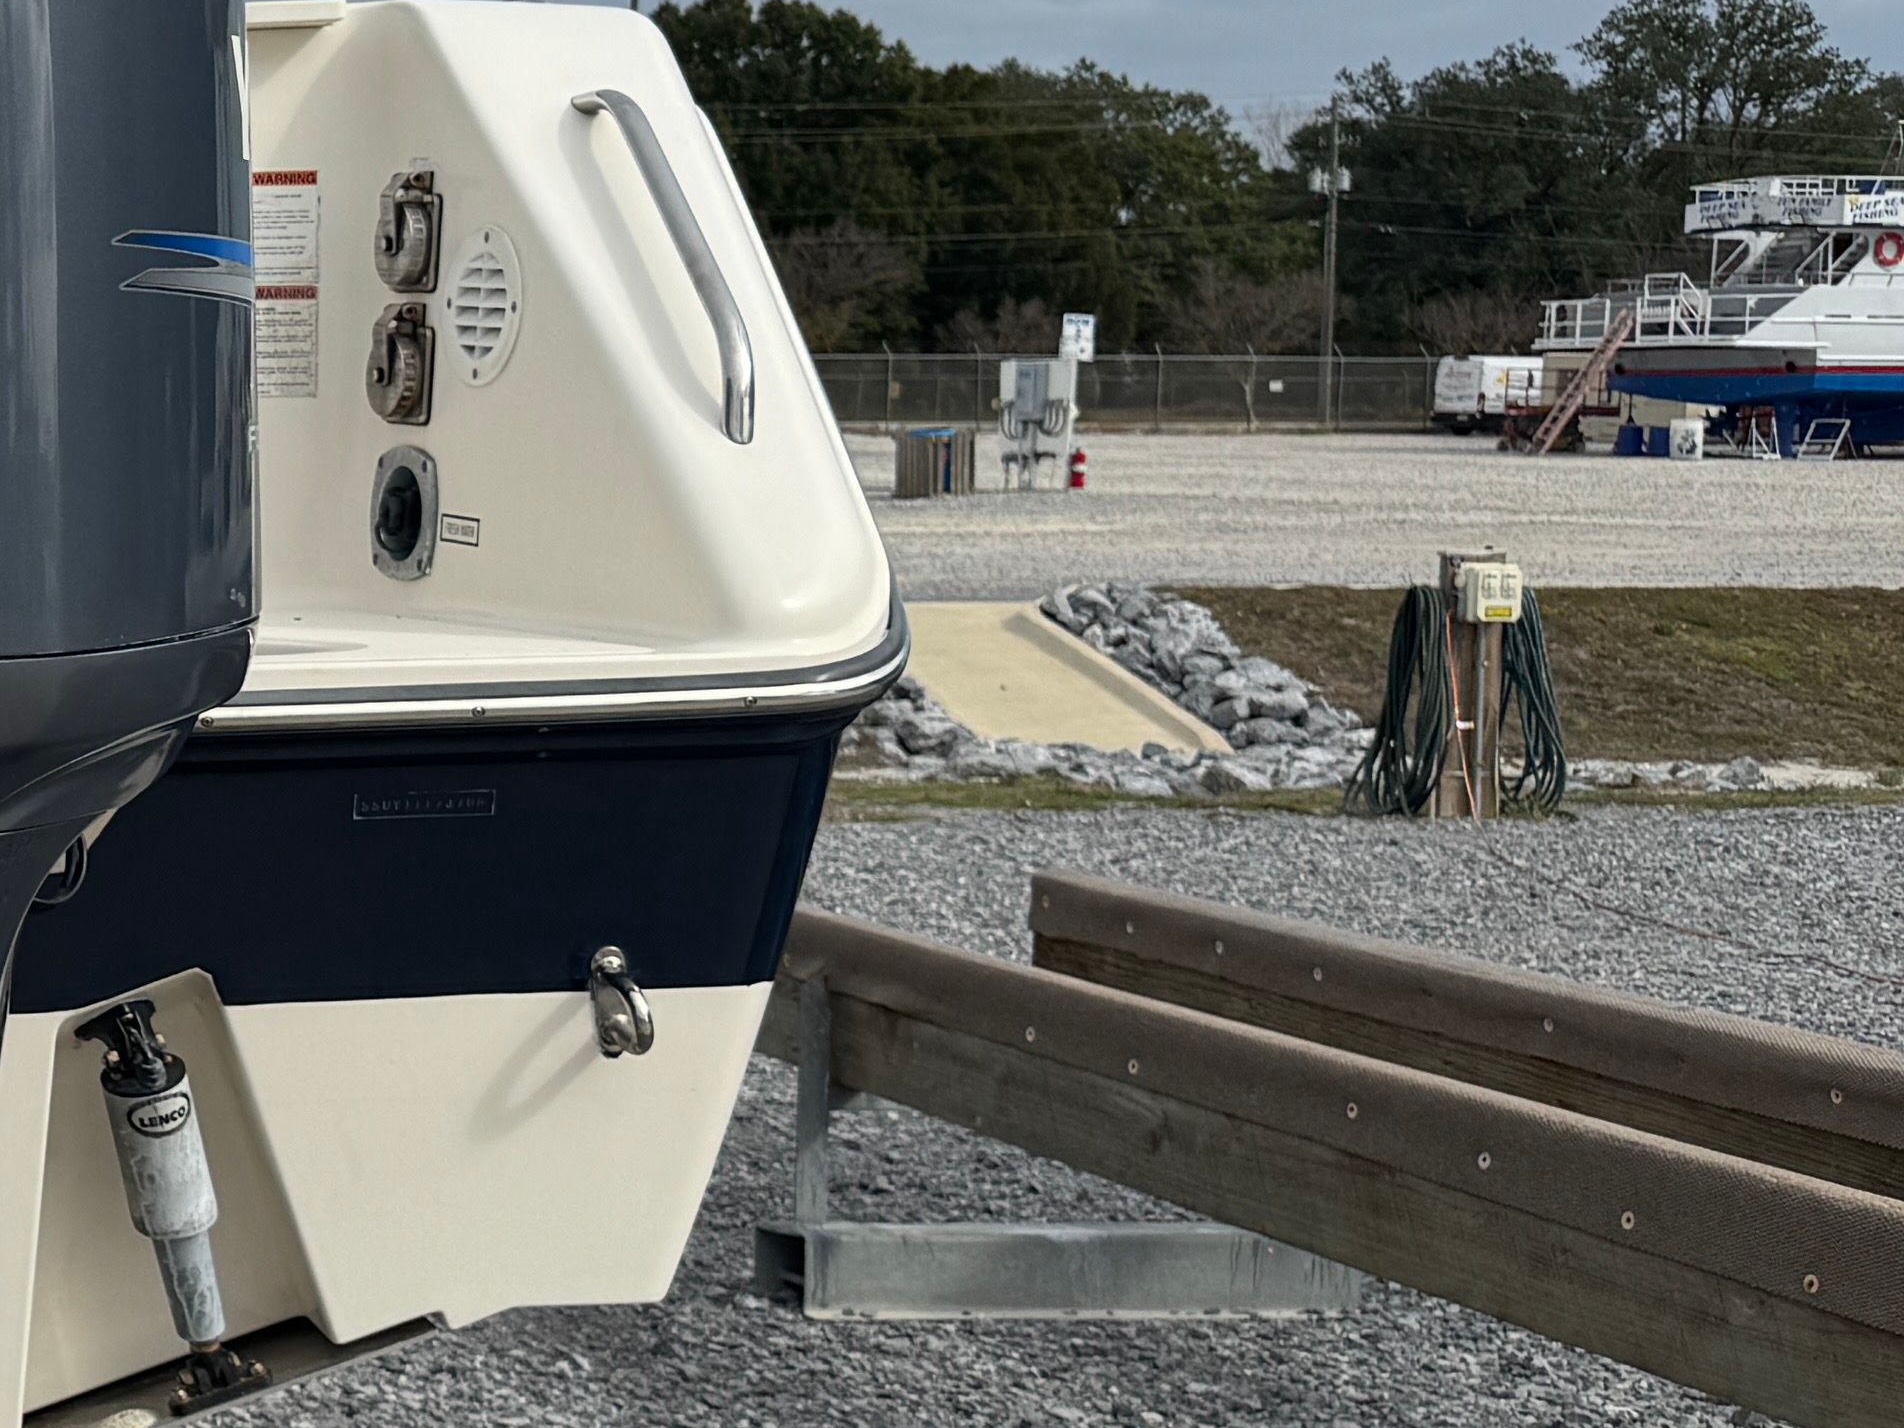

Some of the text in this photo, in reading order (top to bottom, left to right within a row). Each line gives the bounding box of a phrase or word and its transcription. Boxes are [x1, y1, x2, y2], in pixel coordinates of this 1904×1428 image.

[253, 173, 316, 185] WARNING
[256, 286, 316, 300] WARNING
[138, 1105, 185, 1128] LENCO
